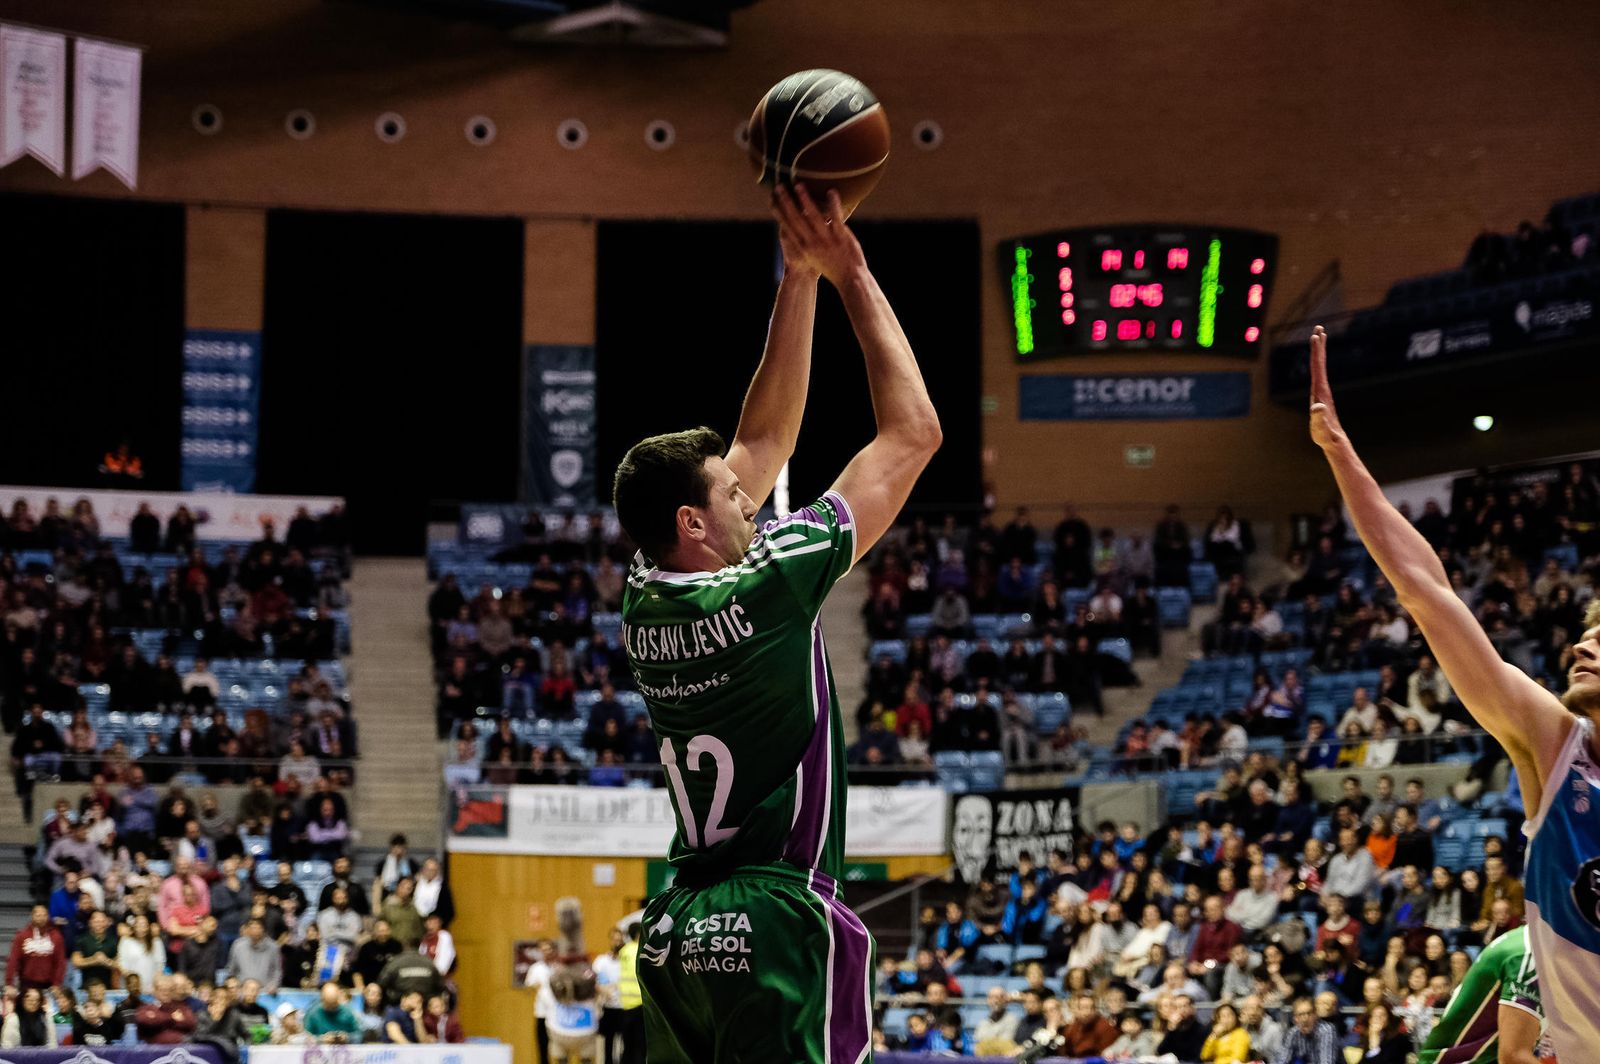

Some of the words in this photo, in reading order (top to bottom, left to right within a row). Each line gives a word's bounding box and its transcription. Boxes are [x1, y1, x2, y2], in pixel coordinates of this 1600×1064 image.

[1097, 377, 1195, 402] cenor
[660, 735, 741, 849] 12
[996, 799, 1073, 834] ZONA
[685, 912, 752, 936] COSTA
[681, 936, 705, 957] DEL
[709, 936, 752, 953] SOL
